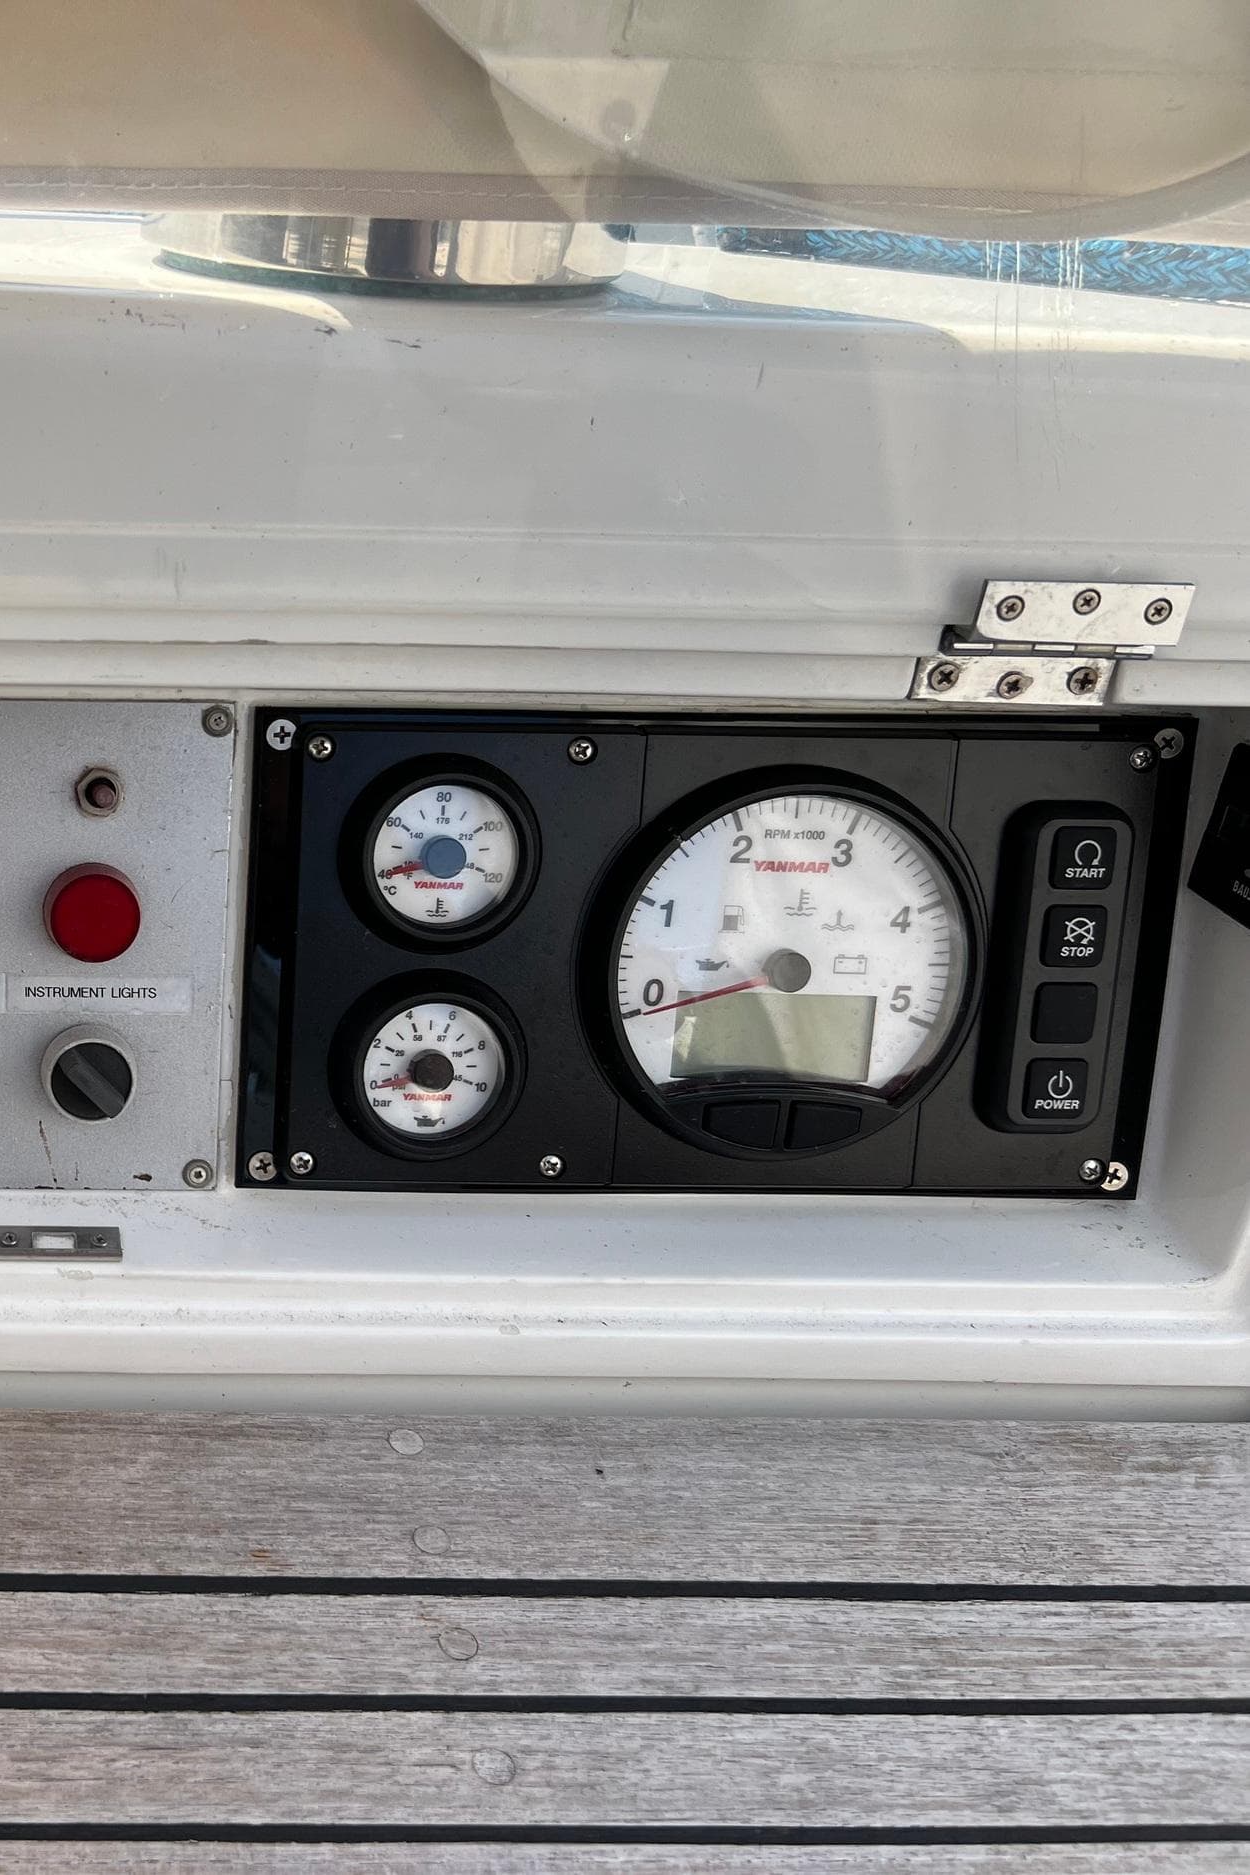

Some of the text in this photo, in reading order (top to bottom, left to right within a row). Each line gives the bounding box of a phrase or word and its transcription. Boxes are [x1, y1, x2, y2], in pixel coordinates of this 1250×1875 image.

[436, 792, 452, 802] 80
[386, 816, 401, 828] 60
[483, 821, 502, 832] 100
[410, 832, 424, 840] 140
[459, 833, 473, 841] 212
[764, 829, 825, 841] RPM x1000
[729, 835, 753, 864] 2
[831, 839, 853, 867] 3
[754, 860, 830, 873] YANMAR
[482, 872, 503, 883] 120
[1065, 867, 1105, 879] START
[414, 881, 464, 890] YANMAR
[659, 899, 675, 927] 1
[890, 906, 911, 933] 4
[1060, 946, 1094, 958] STOP
[24, 986, 158, 1000] INSTRUMENT LIGHTS
[643, 979, 664, 1006] 0
[889, 985, 911, 1013] 5
[405, 1010, 413, 1020] 4
[449, 1011, 456, 1021] 6
[373, 1039, 381, 1049] 2
[478, 1040, 485, 1050] 8
[370, 1080, 377, 1090] 0
[475, 1082, 487, 1092] 10
[373, 1098, 392, 1107] bar
[403, 1093, 452, 1102] YANMAR
[1034, 1099, 1080, 1111] POWER
